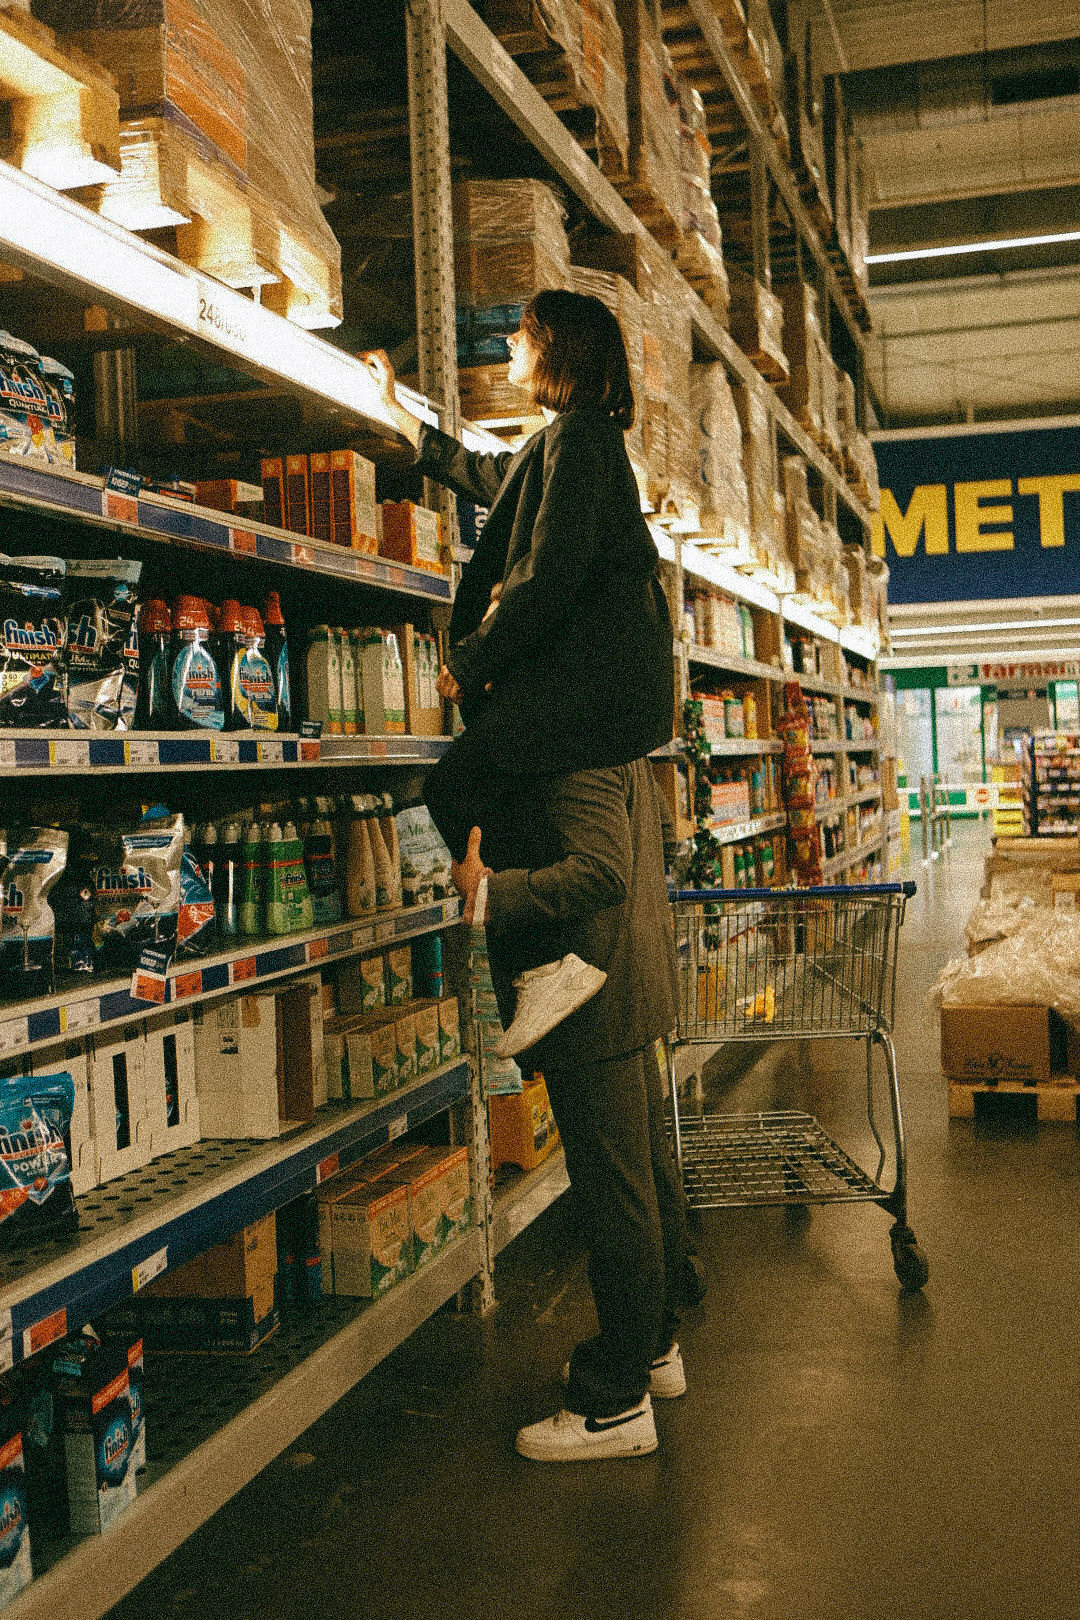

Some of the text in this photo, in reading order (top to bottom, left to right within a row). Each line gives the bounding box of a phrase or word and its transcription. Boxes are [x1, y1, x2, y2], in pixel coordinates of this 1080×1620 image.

[871, 475, 1080, 558] MET
[4, 618, 56, 645] finish
[179, 615, 194, 627] 24
[97, 867, 152, 890] finish
[12, 1152, 59, 1173] POWER
[104, 1424, 129, 1464] finish
